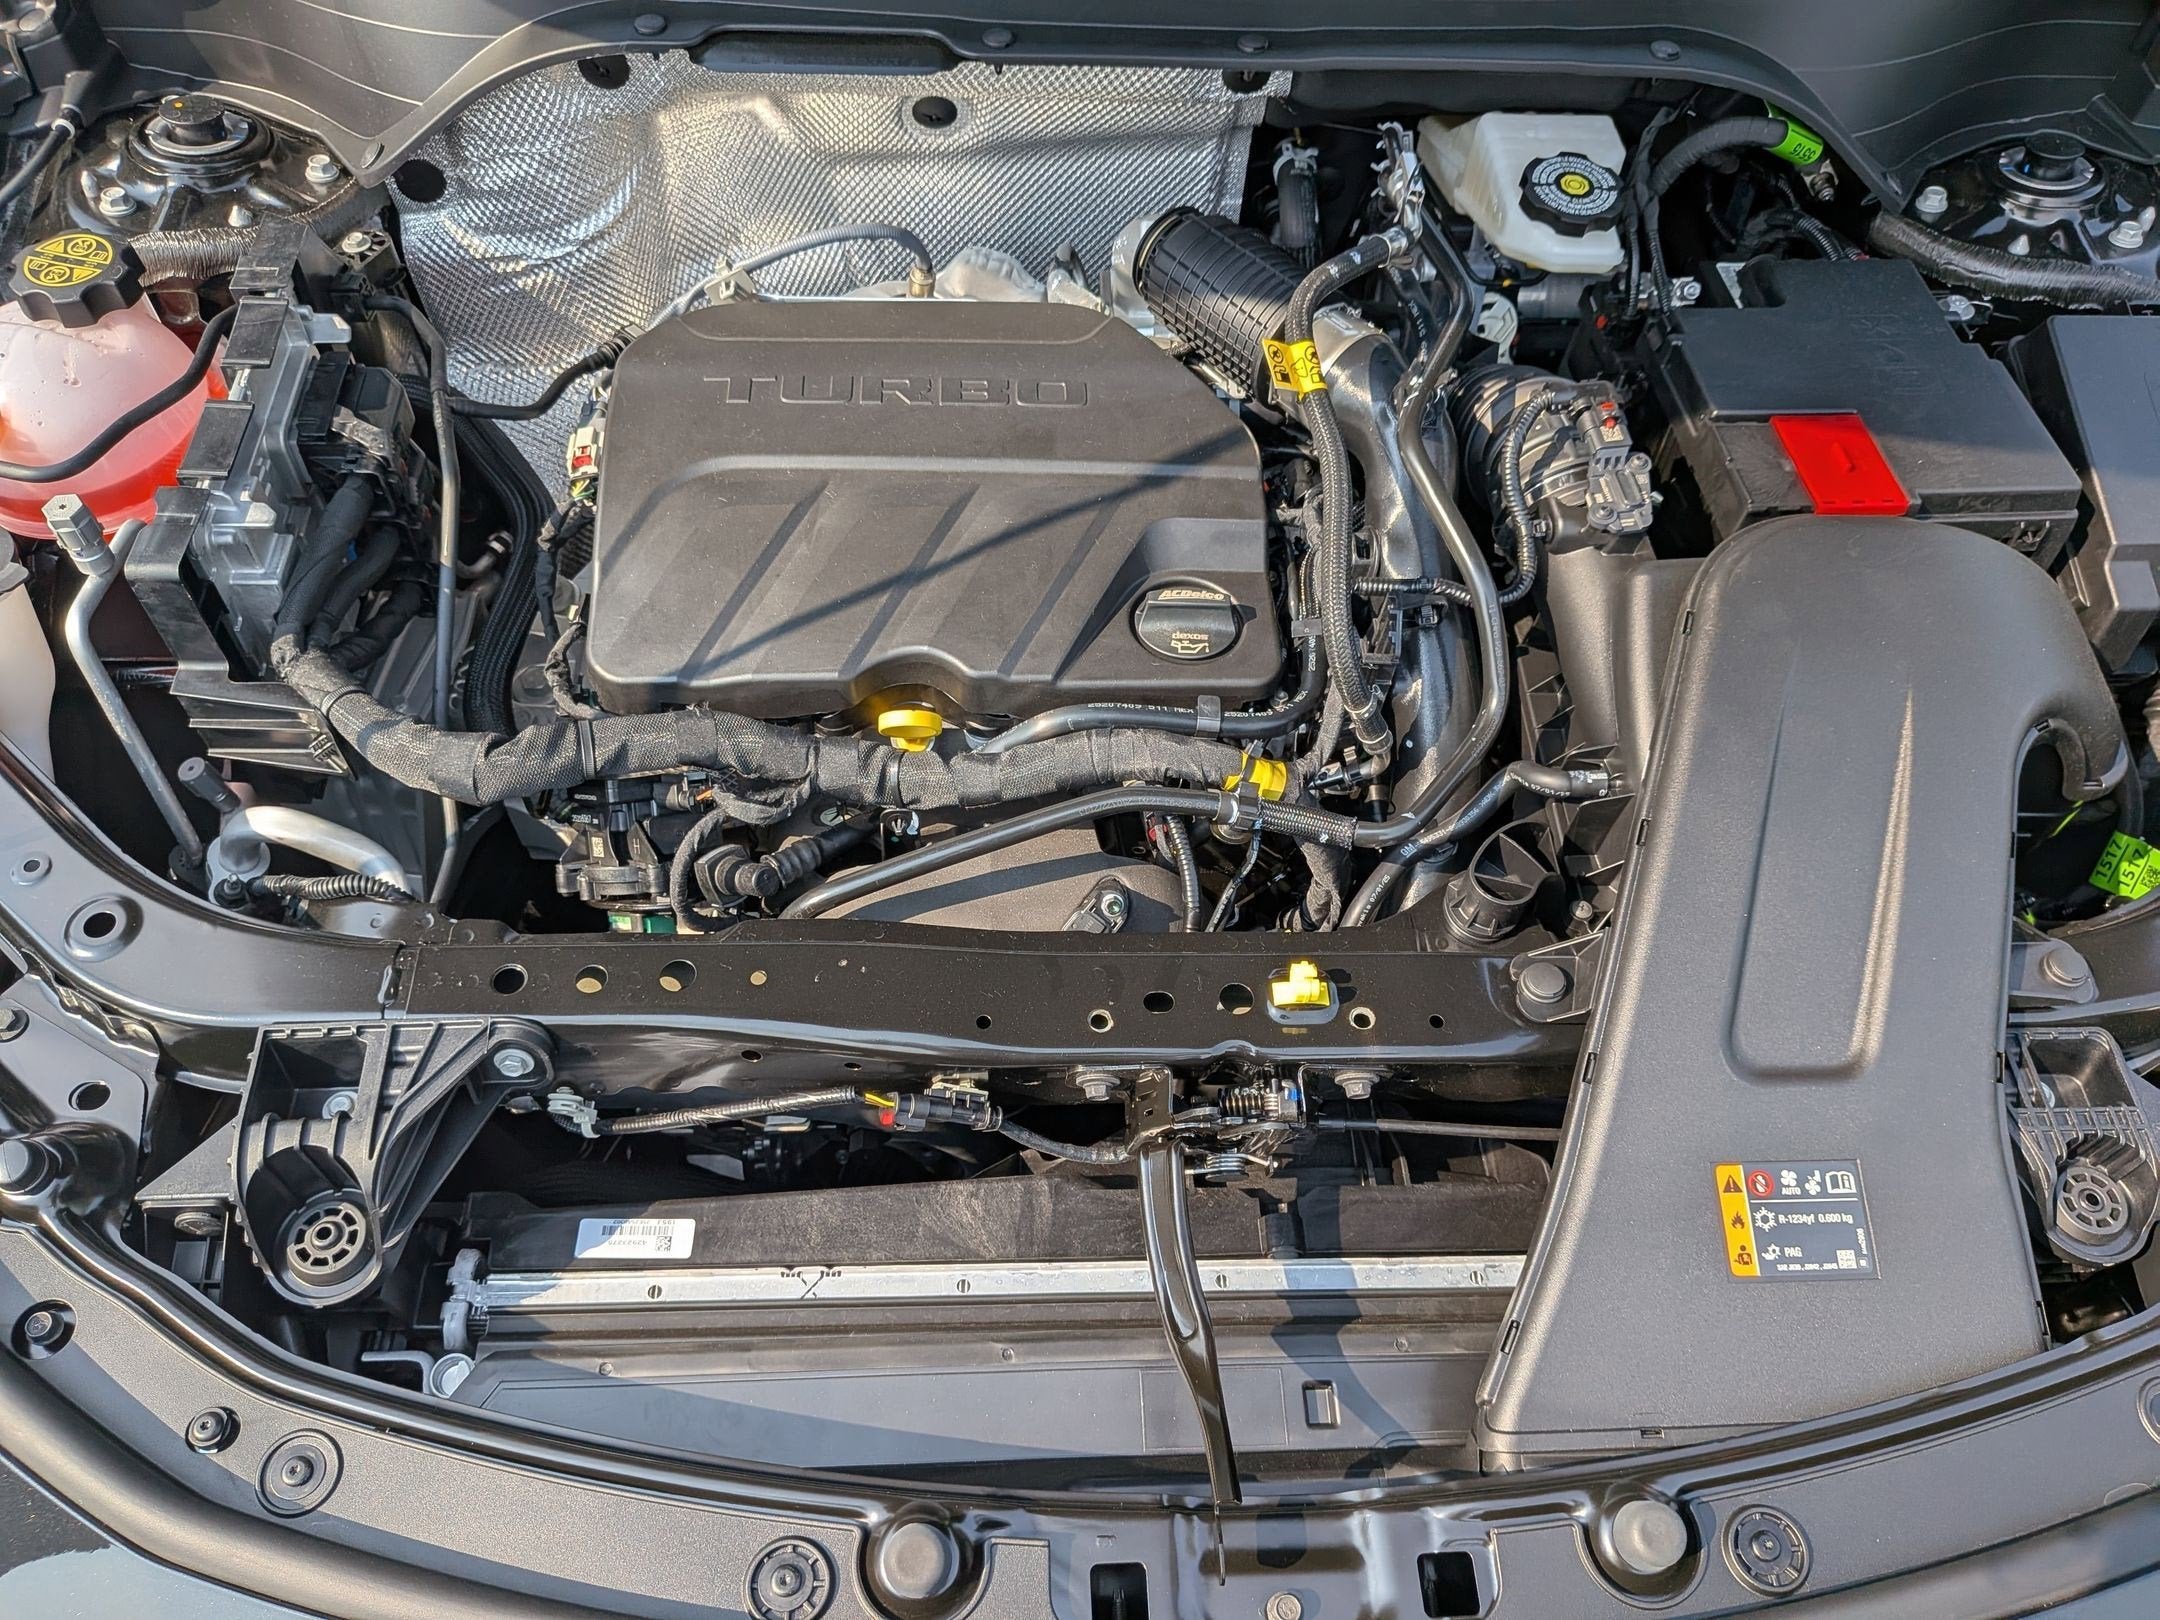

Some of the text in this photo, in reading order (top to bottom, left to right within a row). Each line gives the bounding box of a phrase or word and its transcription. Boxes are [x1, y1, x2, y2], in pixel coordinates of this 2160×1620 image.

[703, 375, 1088, 407] TURBO
[1158, 590, 1225, 601] ACDelco
[1171, 631, 1209, 640] dexos
[2095, 839, 2122, 878] 1517
[2117, 848, 2145, 887] 1517
[1781, 1187, 1801, 1195] AUTO
[1778, 1212, 1853, 1225] R-1234yf 0.600 kg
[1784, 1247, 1803, 1257] PAG
